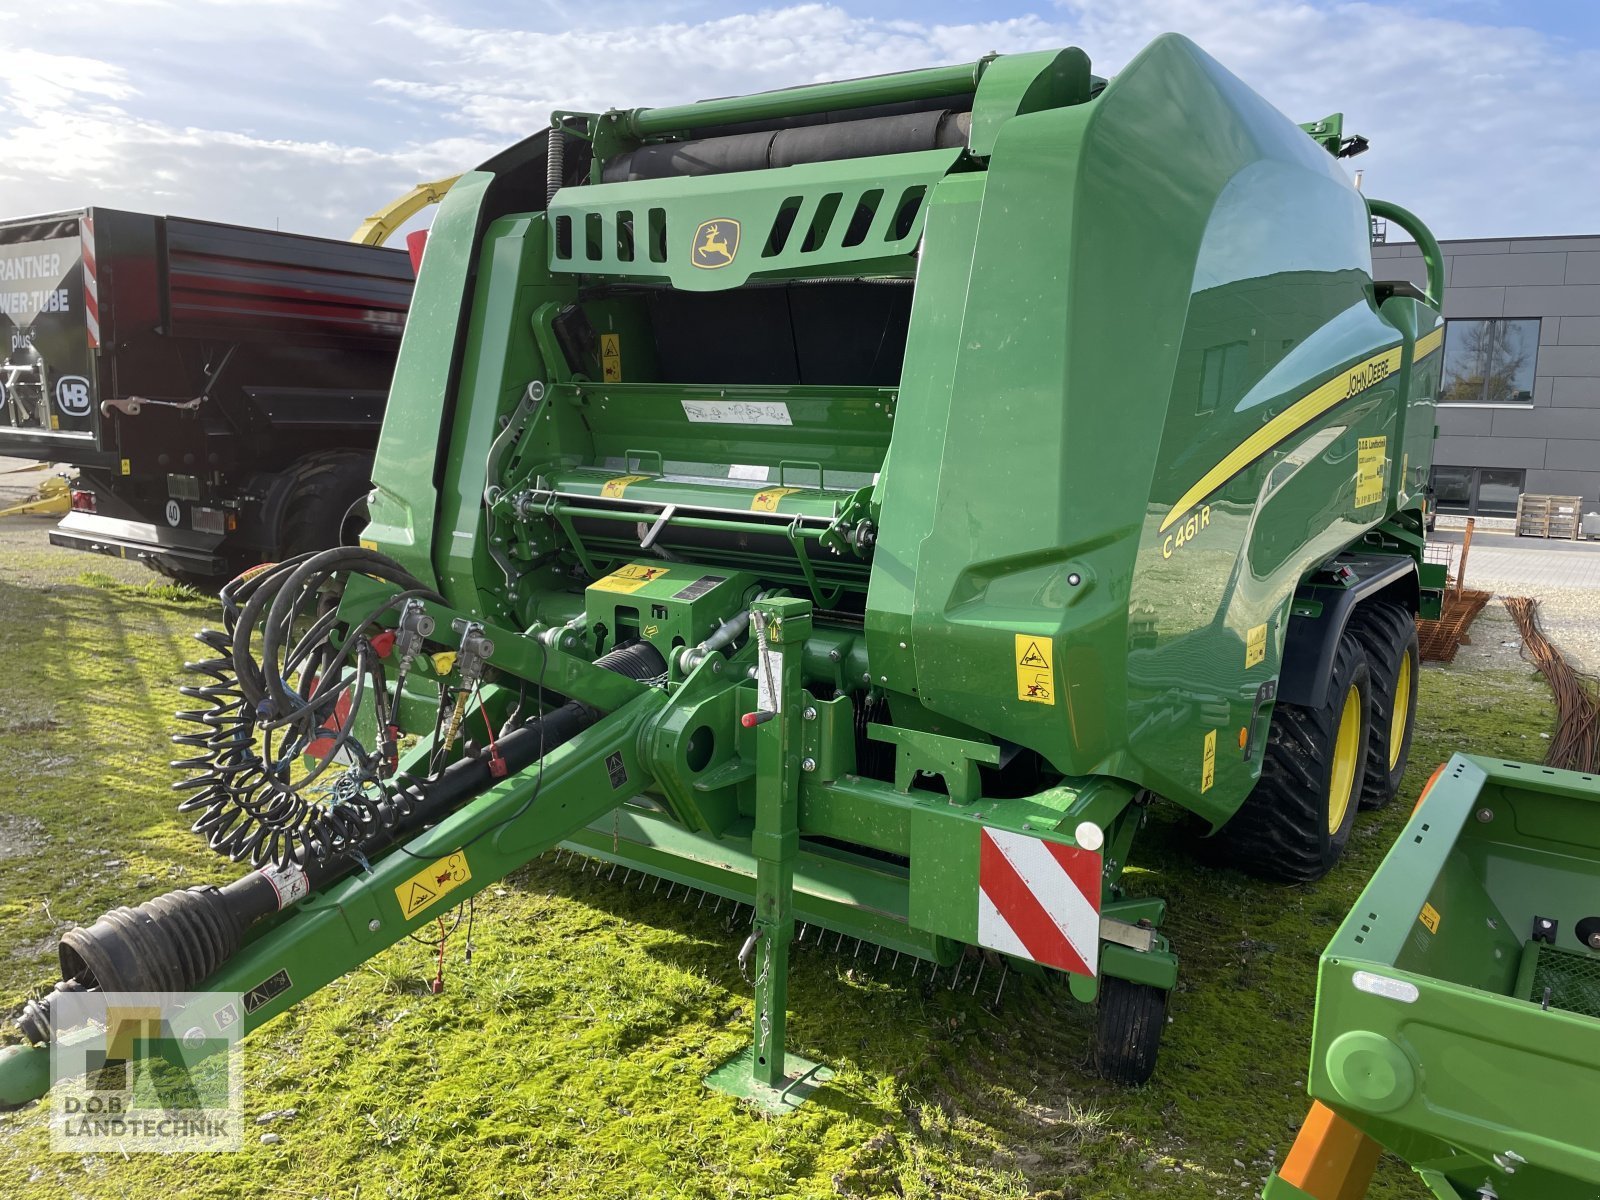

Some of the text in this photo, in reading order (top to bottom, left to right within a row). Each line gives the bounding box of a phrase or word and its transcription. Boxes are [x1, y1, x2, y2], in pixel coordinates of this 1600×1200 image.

[1346, 359, 1389, 397] JOHN DEERE
[61, 383, 89, 408] HB
[168, 505, 178, 521] 40
[1163, 534, 1173, 559] C
